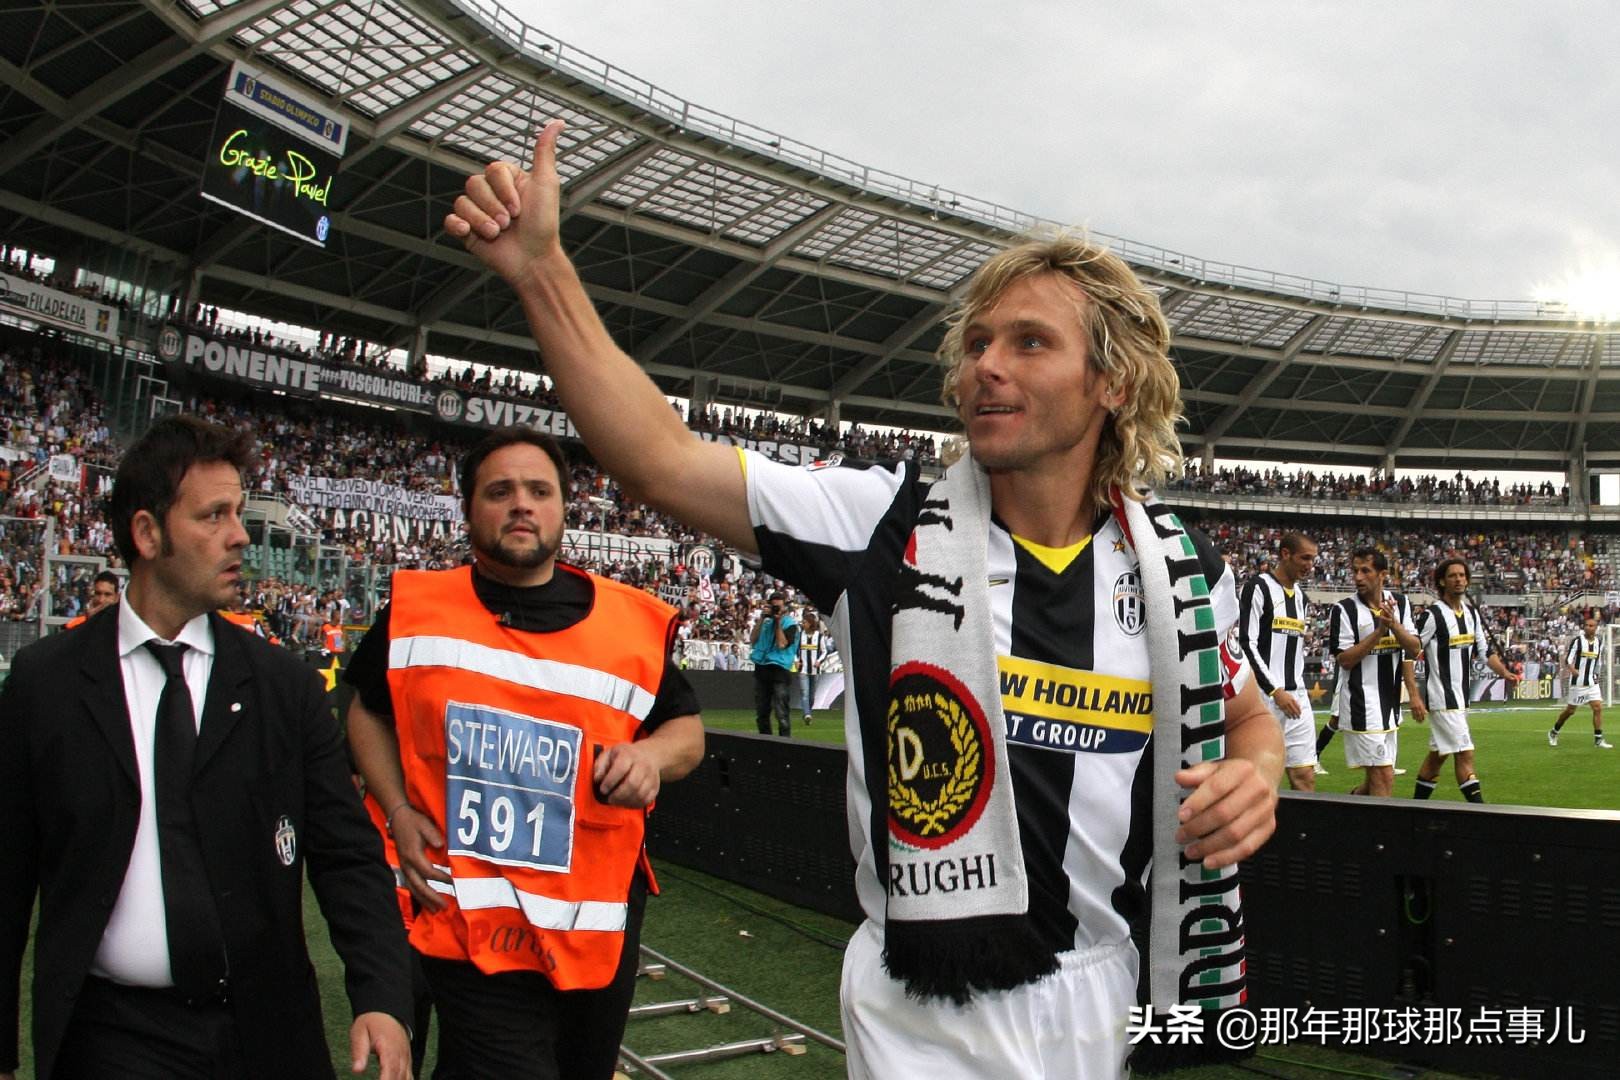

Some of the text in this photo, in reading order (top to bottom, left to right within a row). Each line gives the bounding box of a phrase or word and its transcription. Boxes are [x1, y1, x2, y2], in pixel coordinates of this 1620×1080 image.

[220, 130, 333, 207] Grazie Pavel
[30, 291, 88, 325] FILADELFIA
[185, 335, 421, 404] PONENTE TOSCOLIGURI
[465, 397, 581, 438] SVIZZE
[326, 479, 369, 494] NEDVED
[371, 482, 403, 501] UOMO
[1000, 671, 1153, 716] W HOLLAND
[447, 718, 573, 784] STEWARD
[1032, 720, 1107, 750] GROUP
[457, 789, 545, 857] 591
[889, 853, 999, 898] RUGHI
